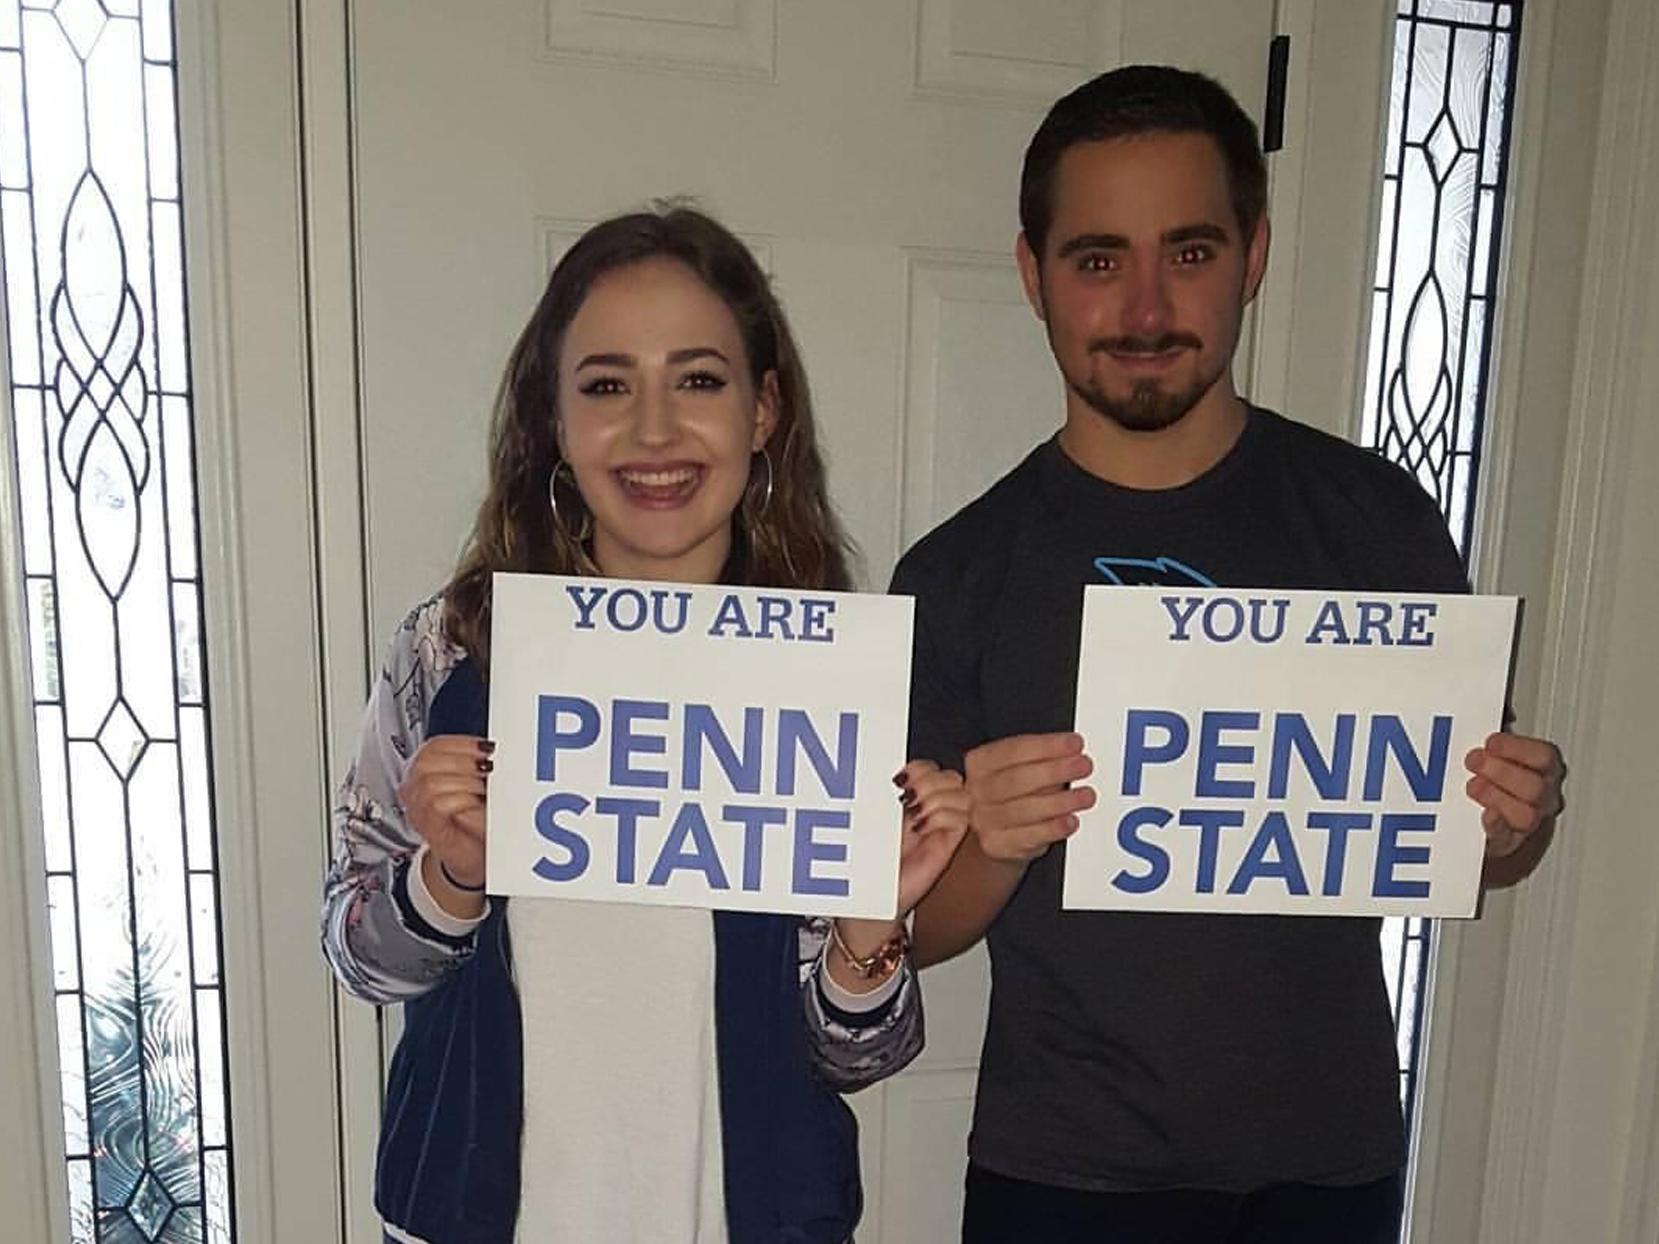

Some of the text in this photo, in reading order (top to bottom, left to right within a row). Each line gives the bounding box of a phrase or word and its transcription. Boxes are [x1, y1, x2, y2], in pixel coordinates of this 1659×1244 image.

[566, 586, 836, 642] YOU ARE
[1161, 597, 1438, 646] YOU ARE
[536, 695, 859, 798] PENN
[1121, 709, 1453, 802] PENN
[532, 793, 851, 896] STATE
[1111, 807, 1437, 898] STATE
